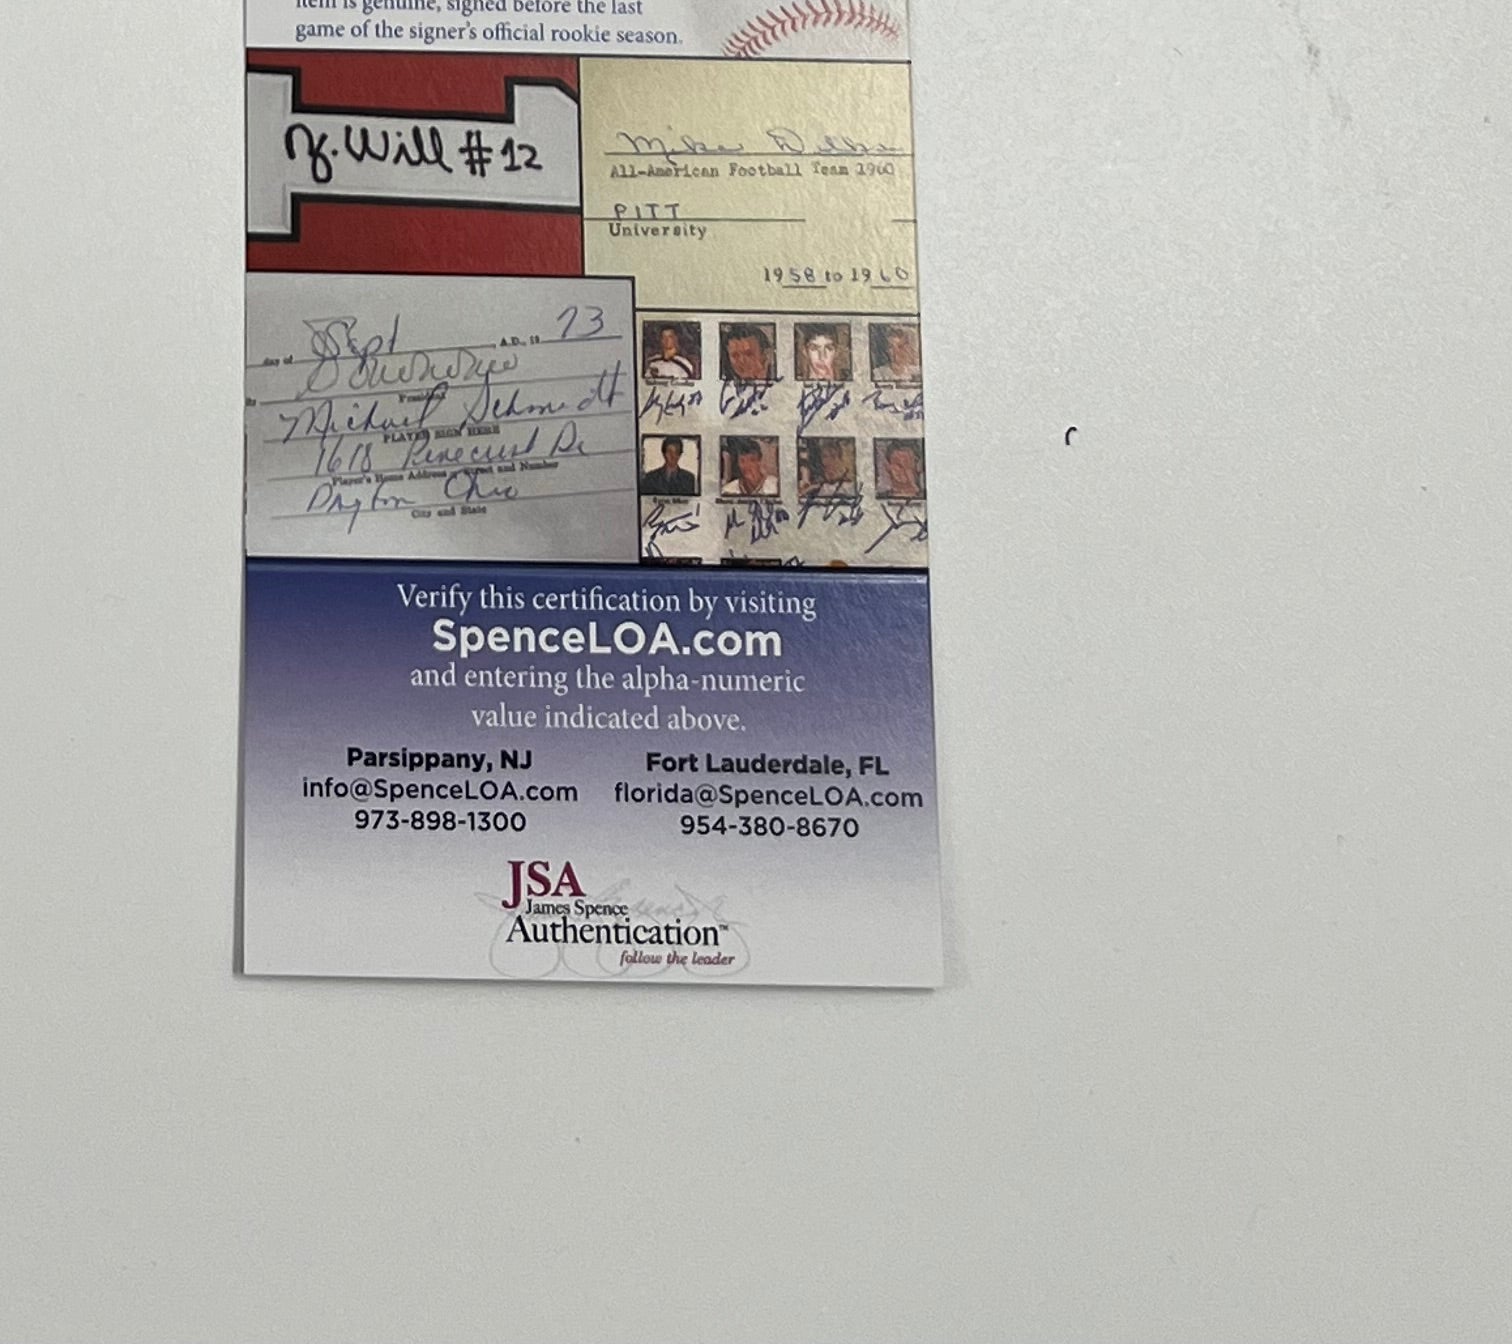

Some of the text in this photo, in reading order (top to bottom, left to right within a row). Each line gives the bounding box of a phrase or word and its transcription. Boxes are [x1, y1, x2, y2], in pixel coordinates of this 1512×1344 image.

[295, 19, 683, 44] game of the signer's official rookie season.
[458, 130, 543, 177] #12
[728, 163, 802, 178] Football
[813, 163, 849, 175] Team
[614, 203, 680, 220] PITT
[609, 223, 707, 239] University
[825, 268, 843, 282] to
[397, 583, 817, 622] Verify this certification by visiting
[432, 617, 782, 656] SpenceLOA.com
[411, 662, 806, 698] and entering the alpha-numeric
[472, 702, 746, 732] value indicated above.
[347, 747, 532, 773] Parsippany, NJ
[646, 752, 890, 779] Fort Lauderdale, FL
[303, 776, 578, 803] info@SpenceLOA.com
[614, 782, 924, 808] florida@SpenceLOA.com
[354, 809, 527, 832] 973-898-1300
[680, 815, 859, 838] 954-380-8670
[501, 860, 587, 909] JSA
[525, 899, 629, 919] James Spence
[620, 950, 735, 967] follow the leader
